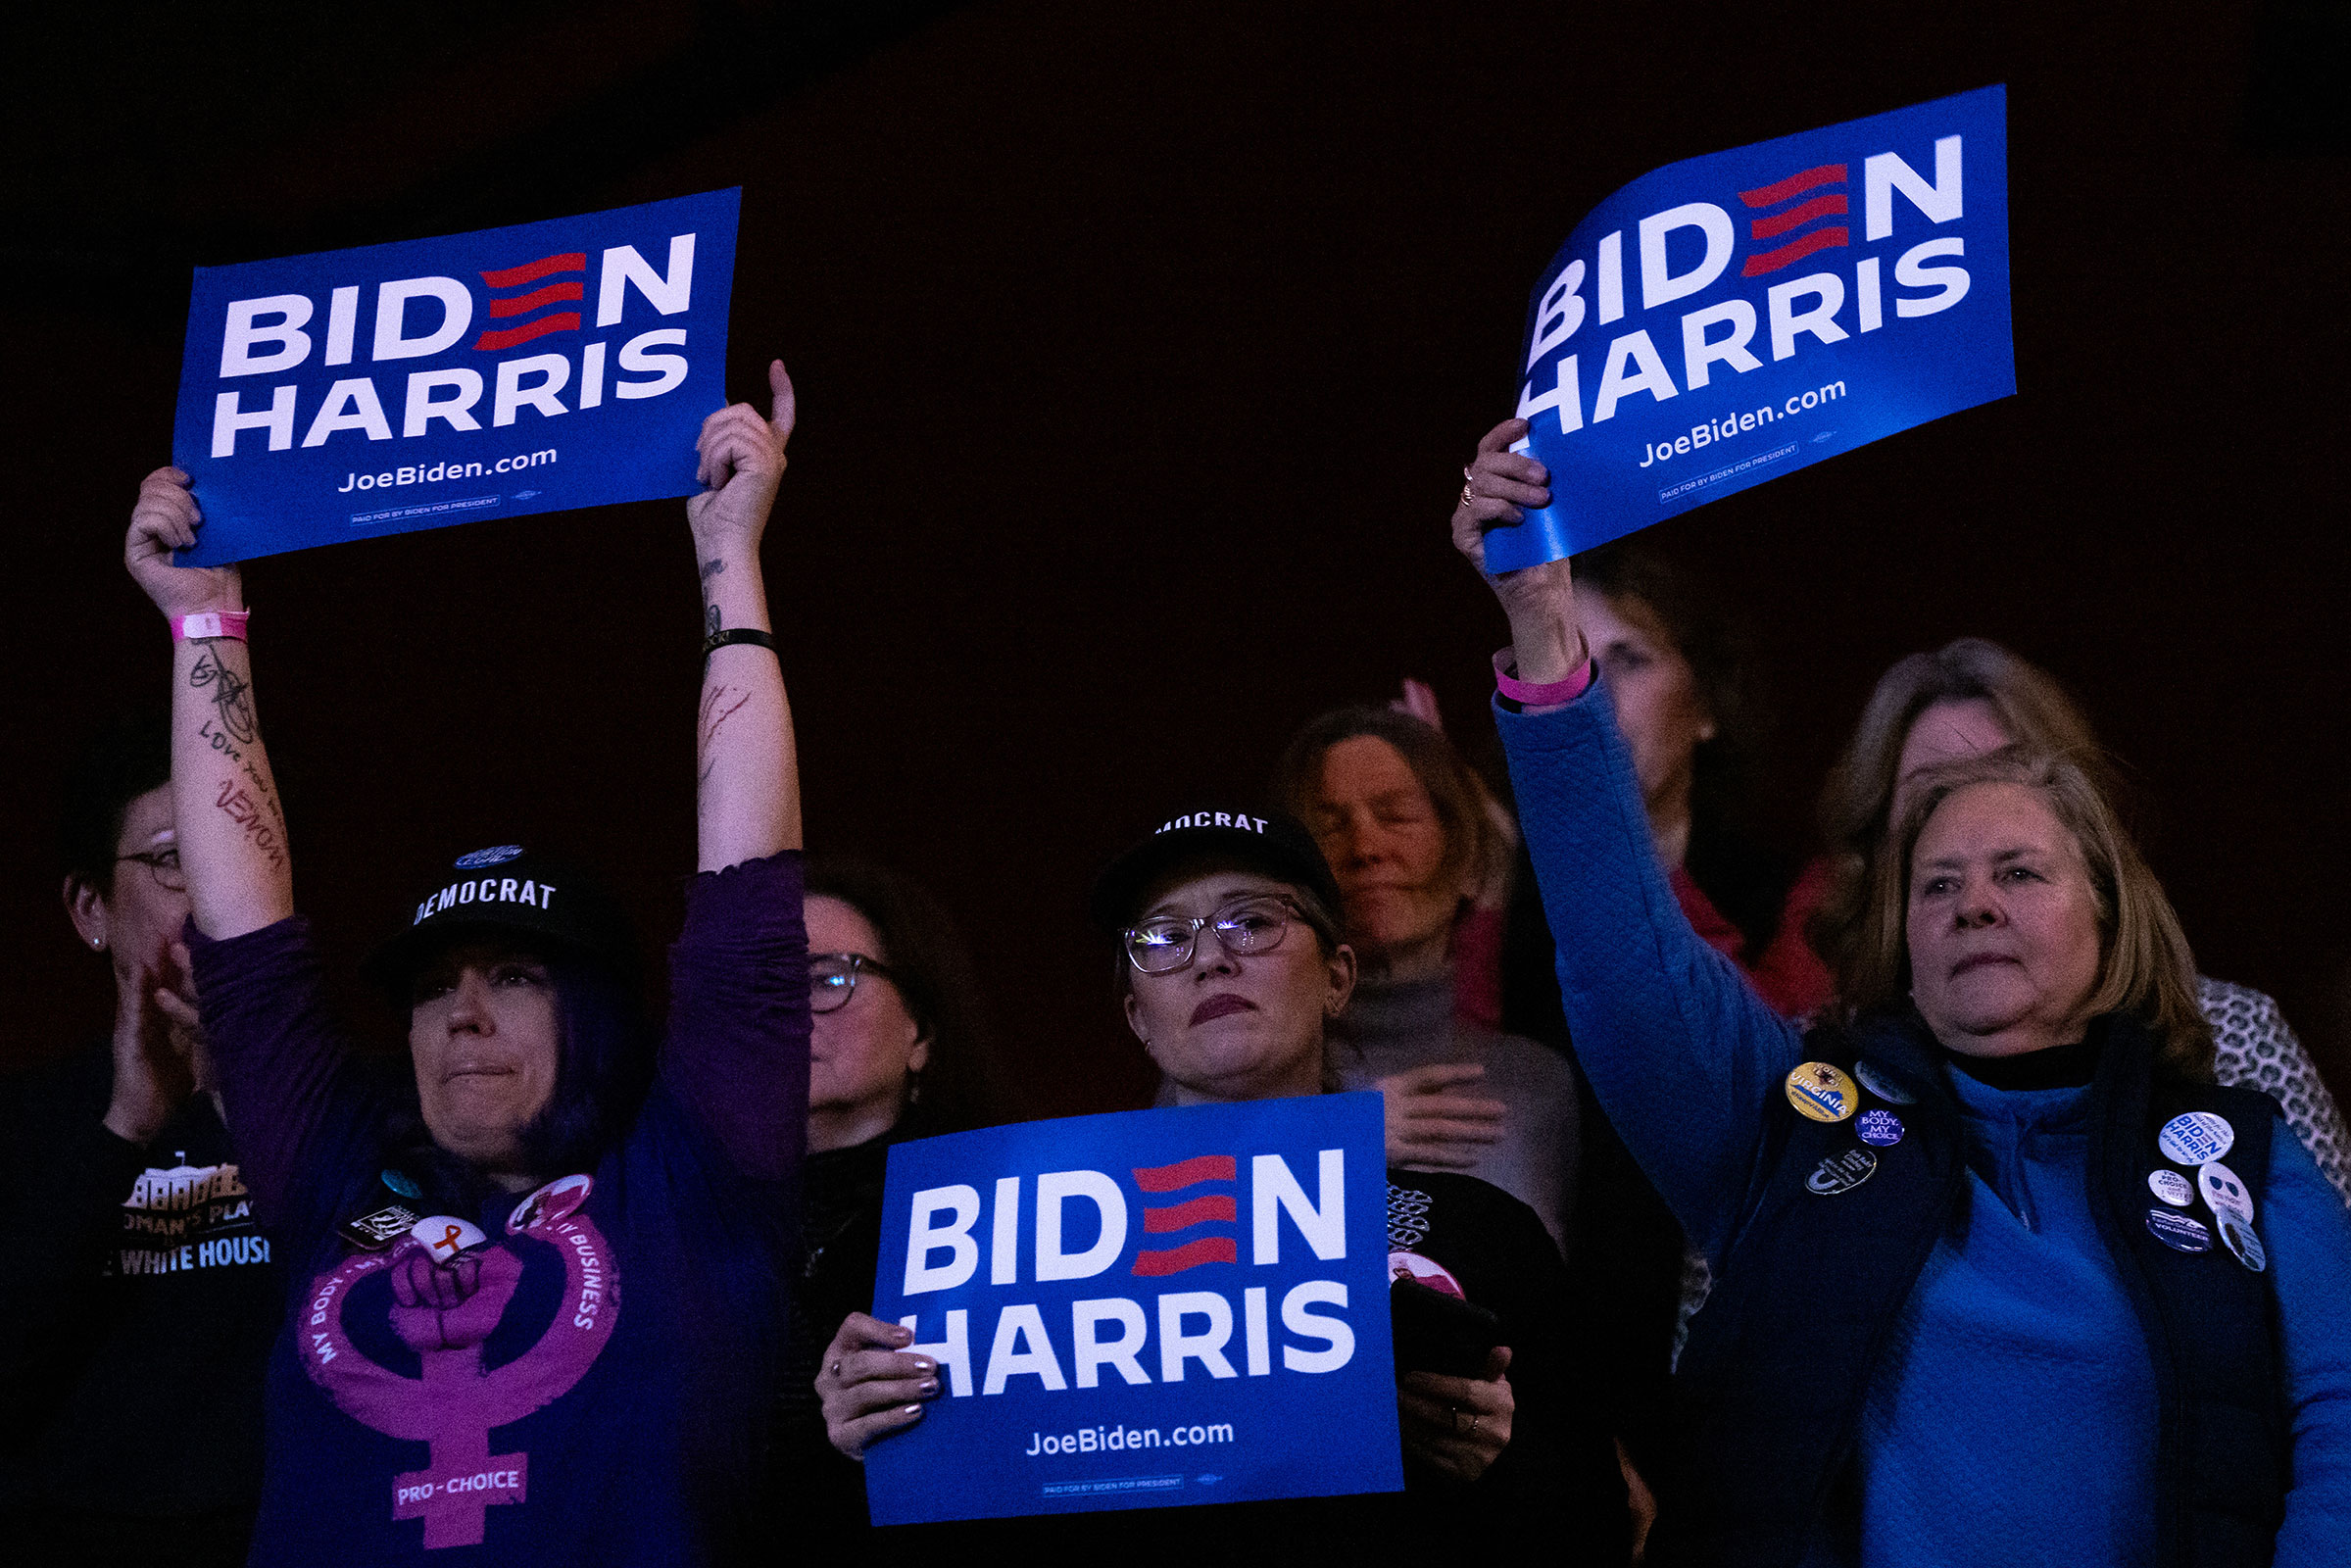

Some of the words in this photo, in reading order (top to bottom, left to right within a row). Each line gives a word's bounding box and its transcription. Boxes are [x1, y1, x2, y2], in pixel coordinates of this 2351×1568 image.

[1526, 135, 1964, 374] BIDEN
[219, 232, 696, 378] BIDEN
[1510, 237, 1971, 454] HARRIS
[211, 328, 689, 459] HARRIS
[1640, 380, 1846, 467] JoeBiden.com
[338, 448, 557, 493] JoeBiden.com
[1661, 488, 1680, 500] PAID
[1681, 481, 1696, 492] FOR
[1697, 477, 1708, 486] BY
[1709, 468, 1734, 482] BIDEN
[1735, 462, 1751, 472] FOR
[1752, 444, 1796, 466] PRESIDENT
[373, 512, 390, 520] FOR
[404, 507, 430, 515] BIDEN
[450, 497, 498, 510] PRESIDENT
[216, 779, 284, 869] VENOM
[413, 878, 557, 926] DEMOCRAT
[1789, 1072, 1848, 1115] VIRGINIA
[1862, 1117, 1899, 1127] BODY,
[2165, 1122, 2210, 1161] HARRIS
[2176, 1115, 2222, 1154] BIDEN
[903, 1149, 1347, 1297] BIDEN
[120, 1244, 194, 1276] WHITE
[568, 1234, 603, 1331] BUSINESS
[311, 1277, 343, 1326] BODY
[312, 1332, 336, 1365] MY
[895, 1280, 1356, 1397] HARRIS
[1026, 1423, 1234, 1456] JoeBiden.com
[397, 1470, 519, 1506] PRO-CHOICE
[1137, 1478, 1181, 1488] PRESIDENT
